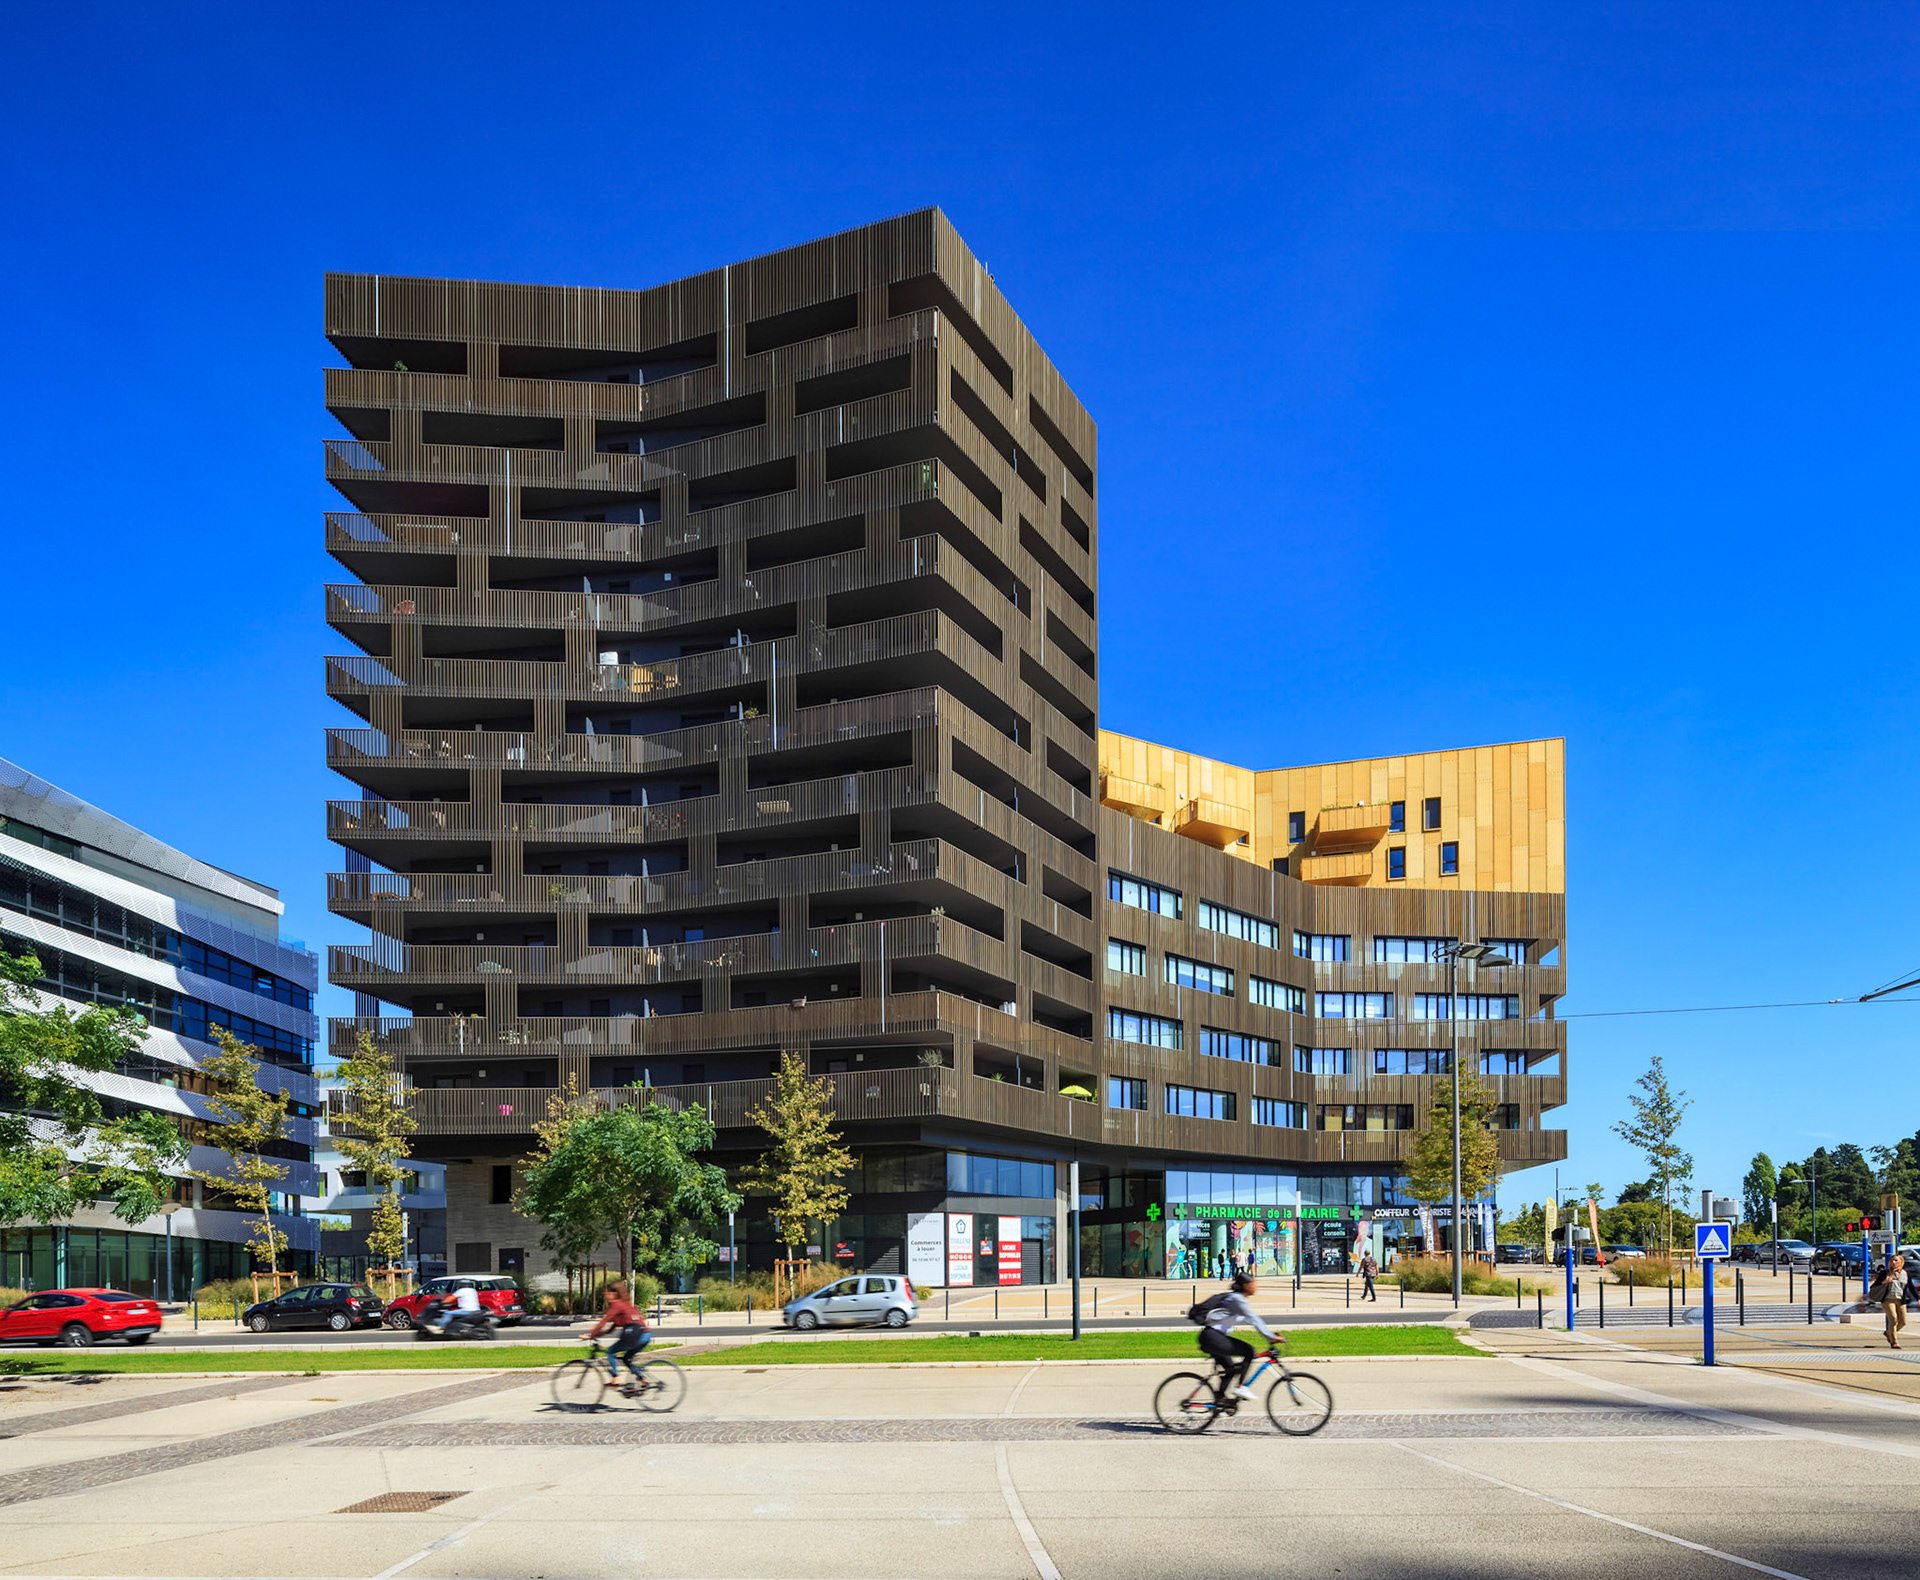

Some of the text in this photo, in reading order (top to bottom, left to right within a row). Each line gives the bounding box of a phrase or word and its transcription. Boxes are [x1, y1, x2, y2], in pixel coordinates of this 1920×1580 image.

[1195, 1206, 1339, 1219] PHARMACIE de la MAIRIE
[1374, 1208, 1410, 1217] COIFFEUR
